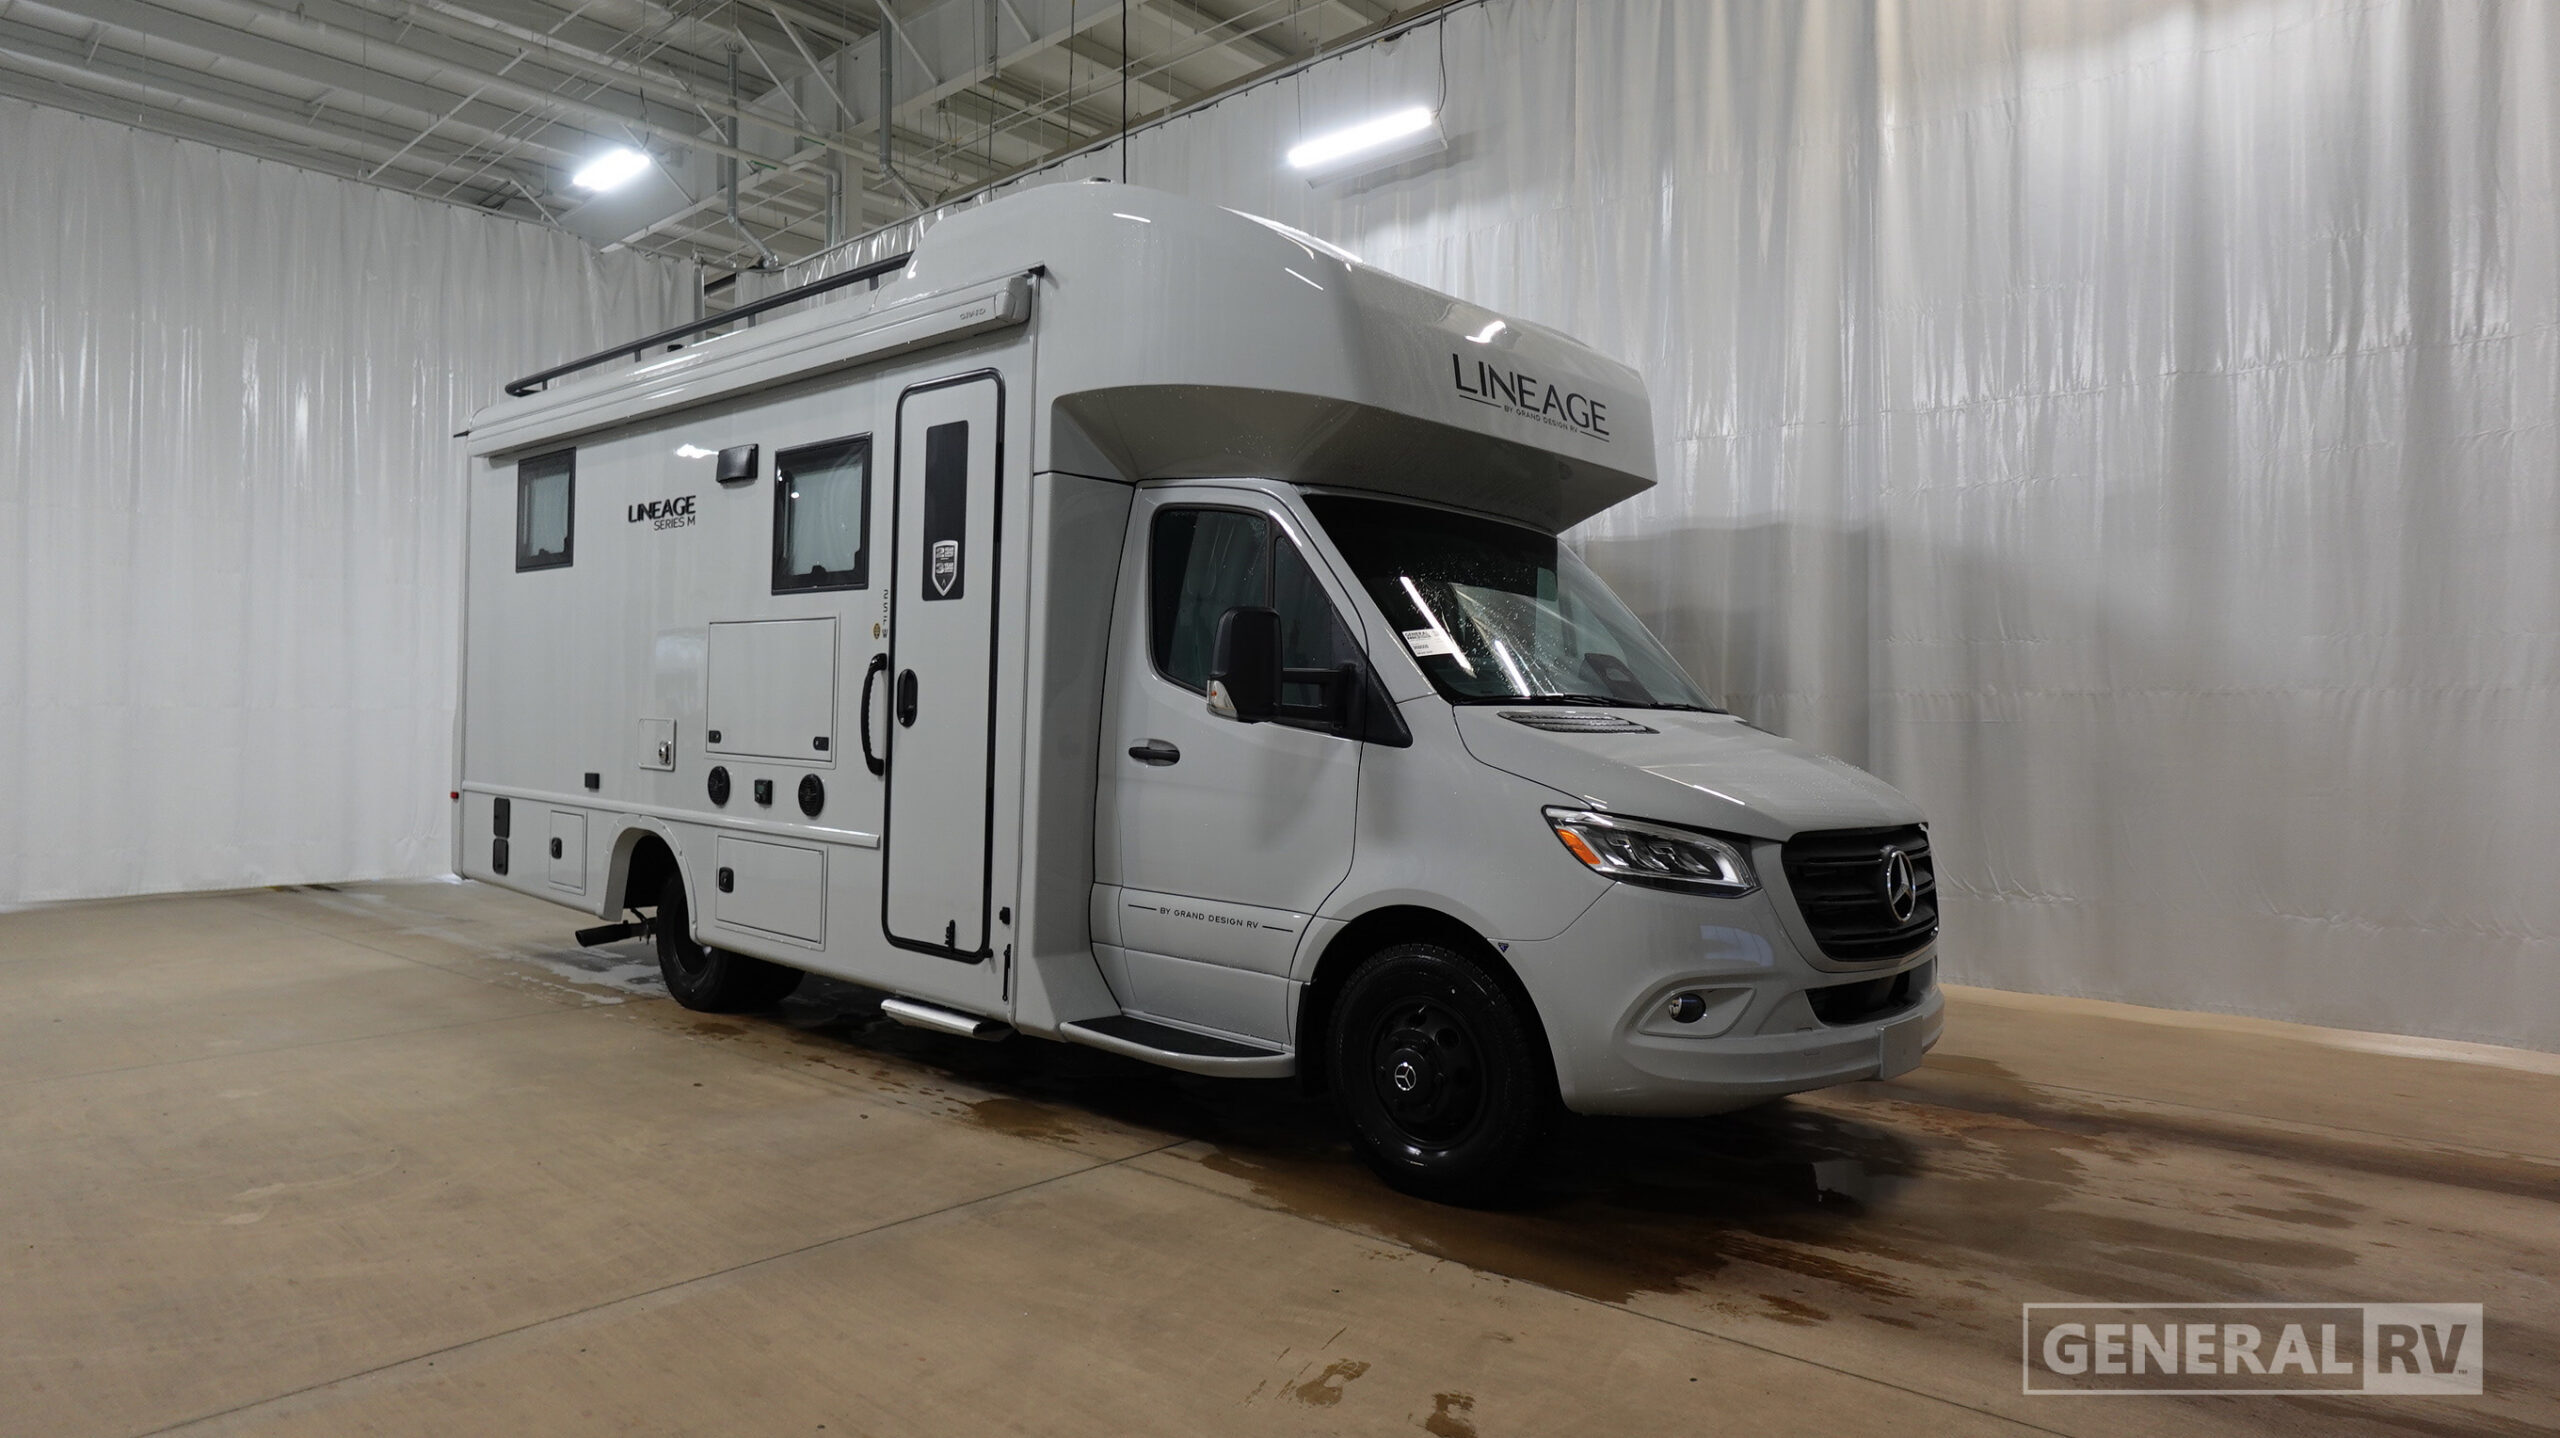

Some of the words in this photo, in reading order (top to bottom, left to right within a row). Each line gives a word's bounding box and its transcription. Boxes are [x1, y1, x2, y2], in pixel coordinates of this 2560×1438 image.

[1452, 353, 1609, 436] LINEAGE
[1503, 404, 1513, 413] BY
[1516, 408, 1541, 422] GRAND
[1543, 417, 1568, 430] DESIGN
[628, 495, 696, 523] LINEAGE
[654, 517, 685, 531] SERIES
[687, 515, 696, 527] M
[1160, 907, 1171, 915] BY
[1174, 909, 1205, 921] GRAND
[1208, 914, 1243, 927] DESIGN
[1246, 920, 1259, 929] RV
